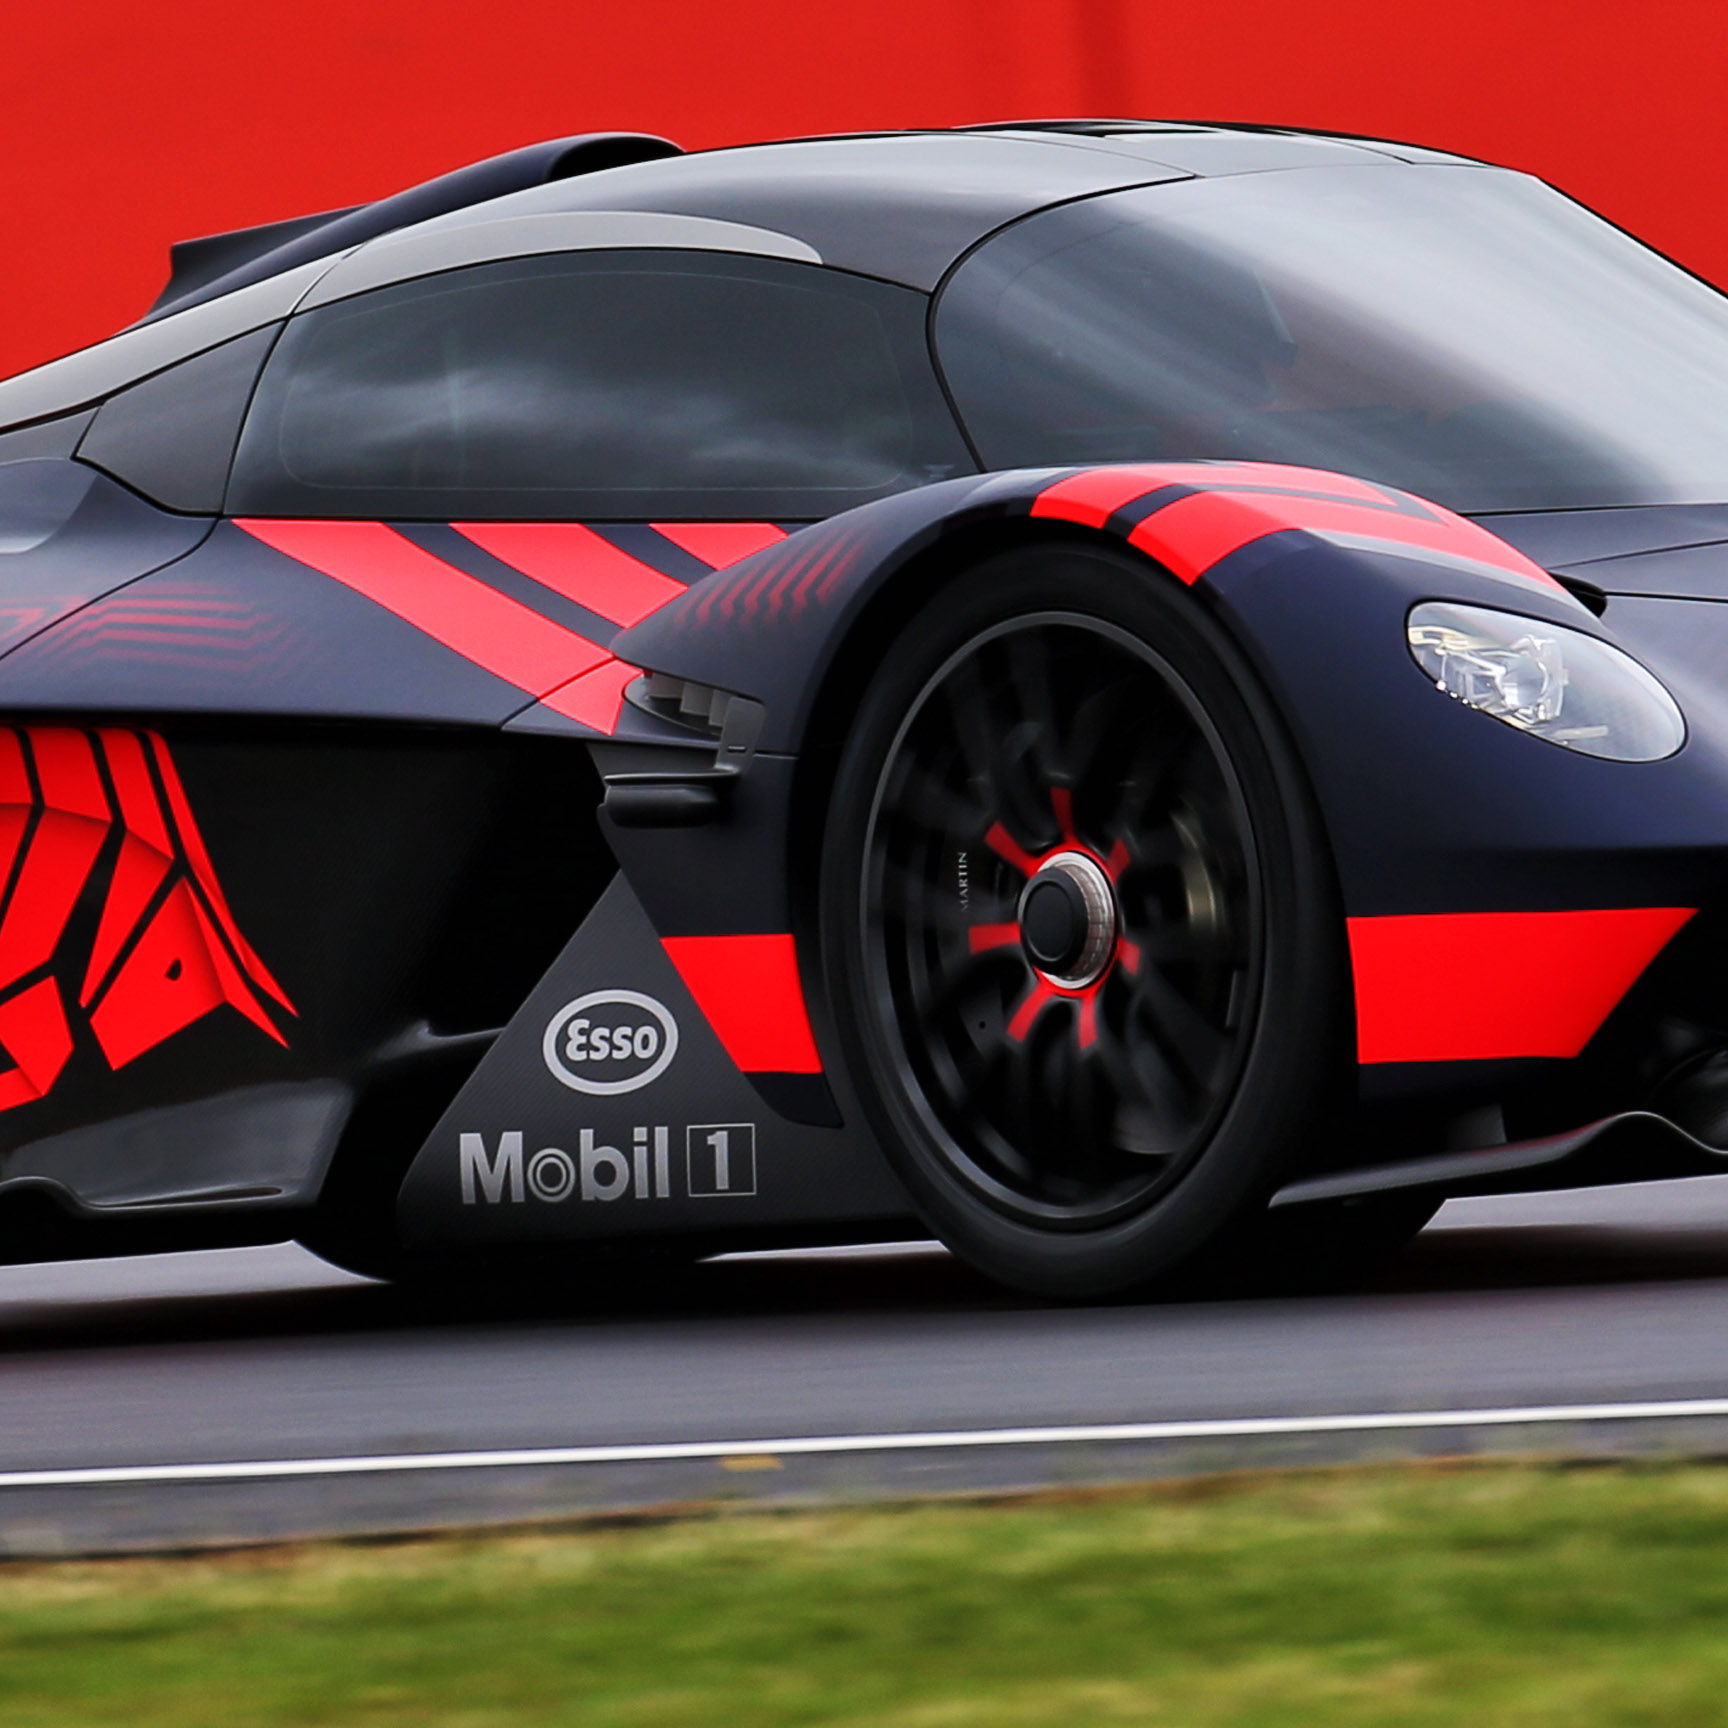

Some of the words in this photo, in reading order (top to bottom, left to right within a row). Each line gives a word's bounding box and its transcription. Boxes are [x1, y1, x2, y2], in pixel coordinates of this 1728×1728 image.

[565, 1019, 659, 1062] Esso
[459, 1126, 671, 1205] Mobil
[706, 1130, 730, 1191] 1
